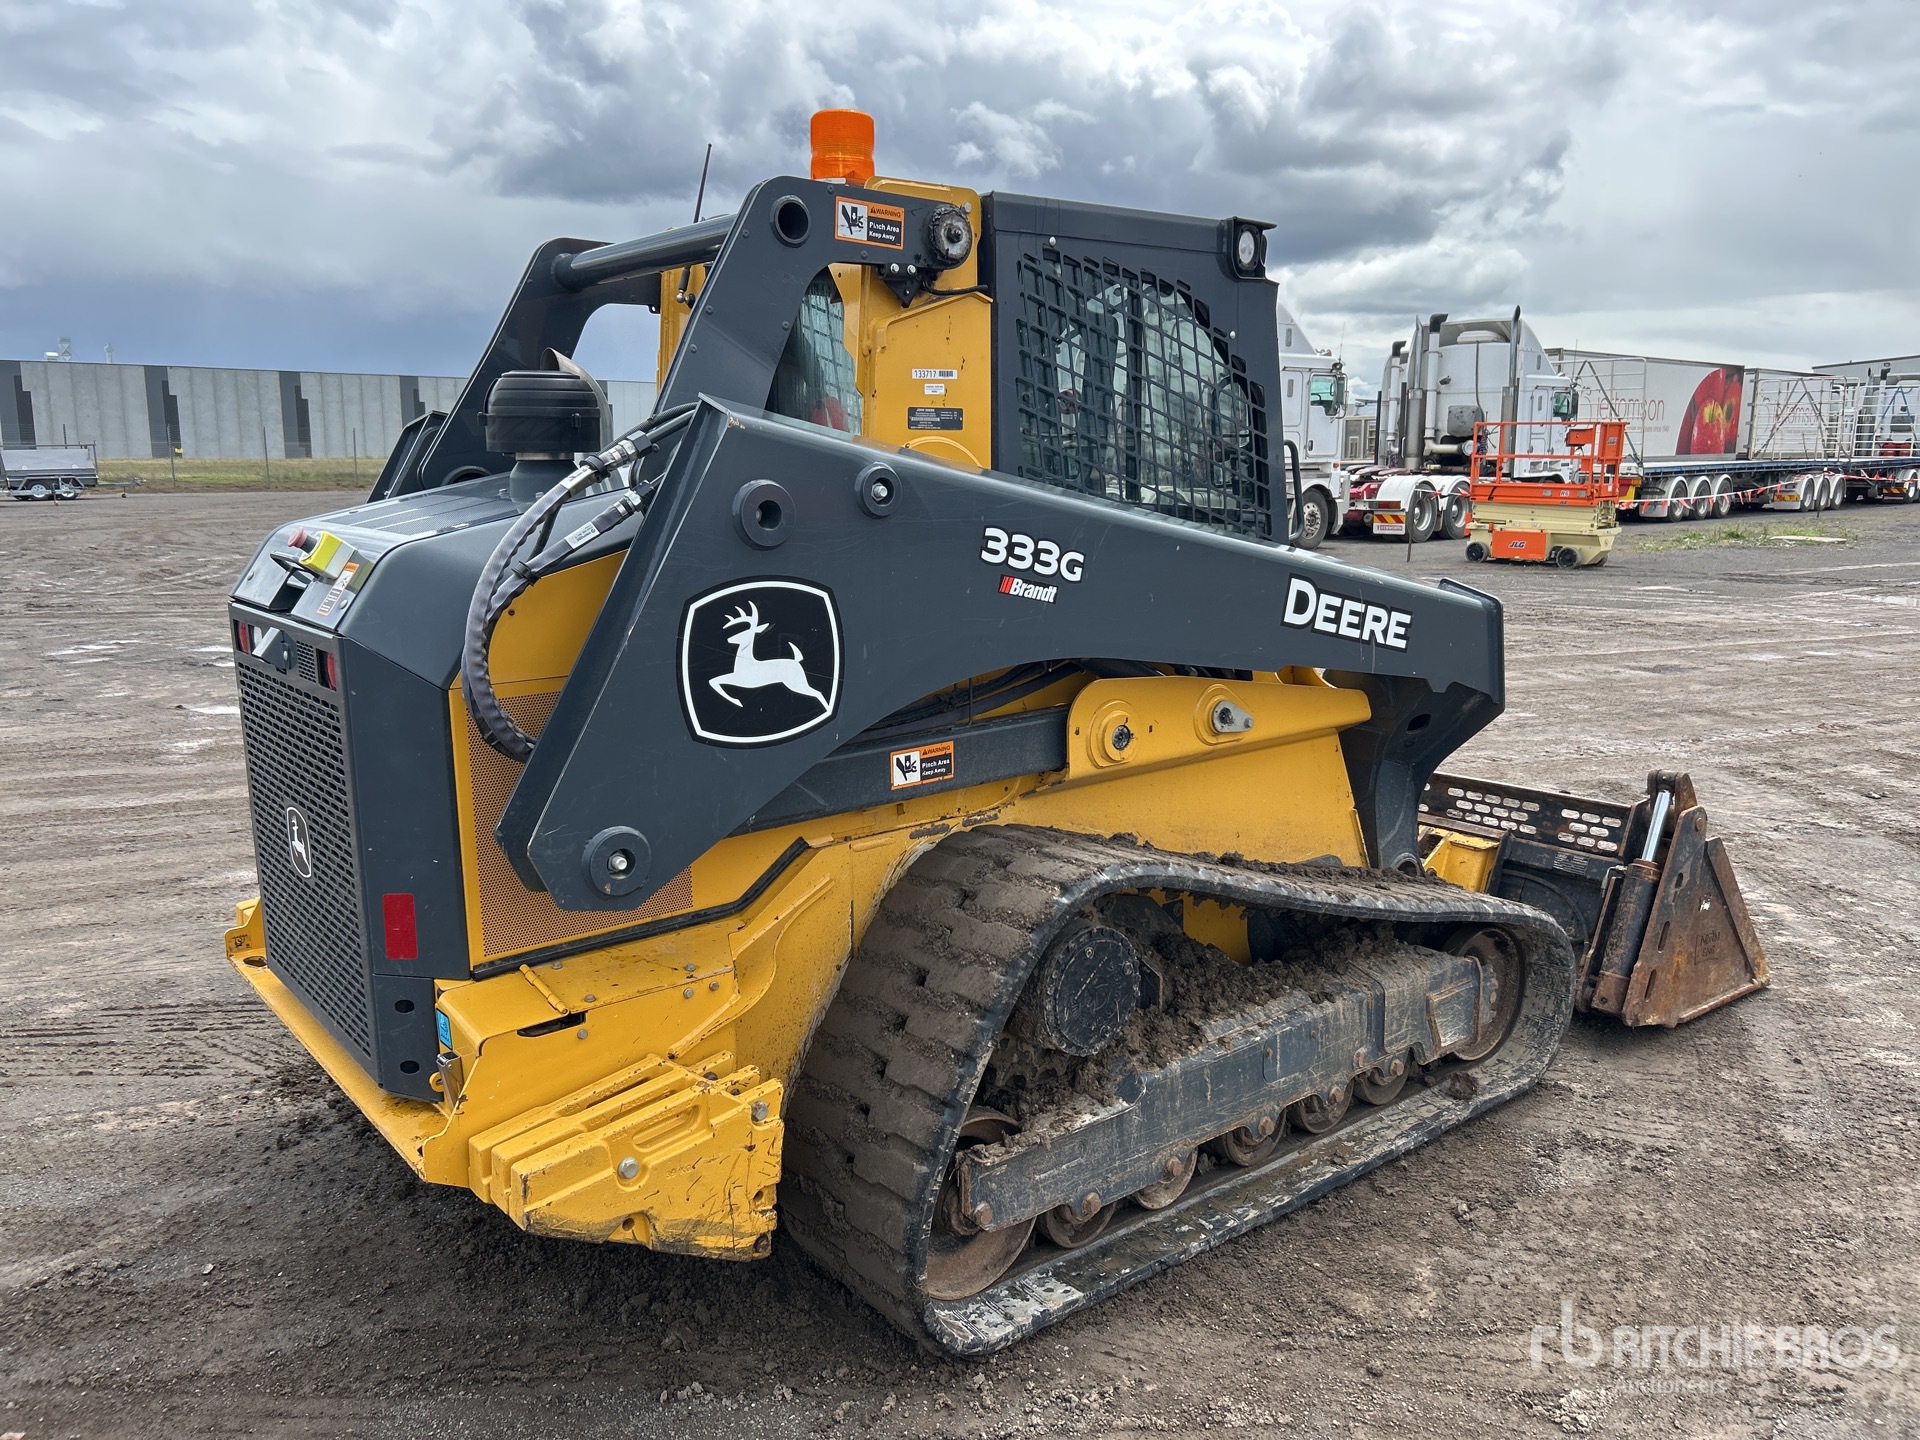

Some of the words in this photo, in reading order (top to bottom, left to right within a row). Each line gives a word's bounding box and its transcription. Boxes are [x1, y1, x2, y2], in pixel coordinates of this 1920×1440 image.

[875, 207, 901, 217] WARNING
[869, 221, 886, 231] Pinch
[886, 224, 900, 233] Area
[868, 230, 882, 239] Keep
[882, 233, 896, 242] Away
[914, 369, 937, 379] 133717
[981, 527, 1085, 582] 333G
[1009, 578, 1057, 603] Brandt
[1283, 577, 1412, 649] DEERE
[927, 745, 951, 753] WARNING
[922, 761, 937, 769] Pinch
[937, 758, 950, 766] Area
